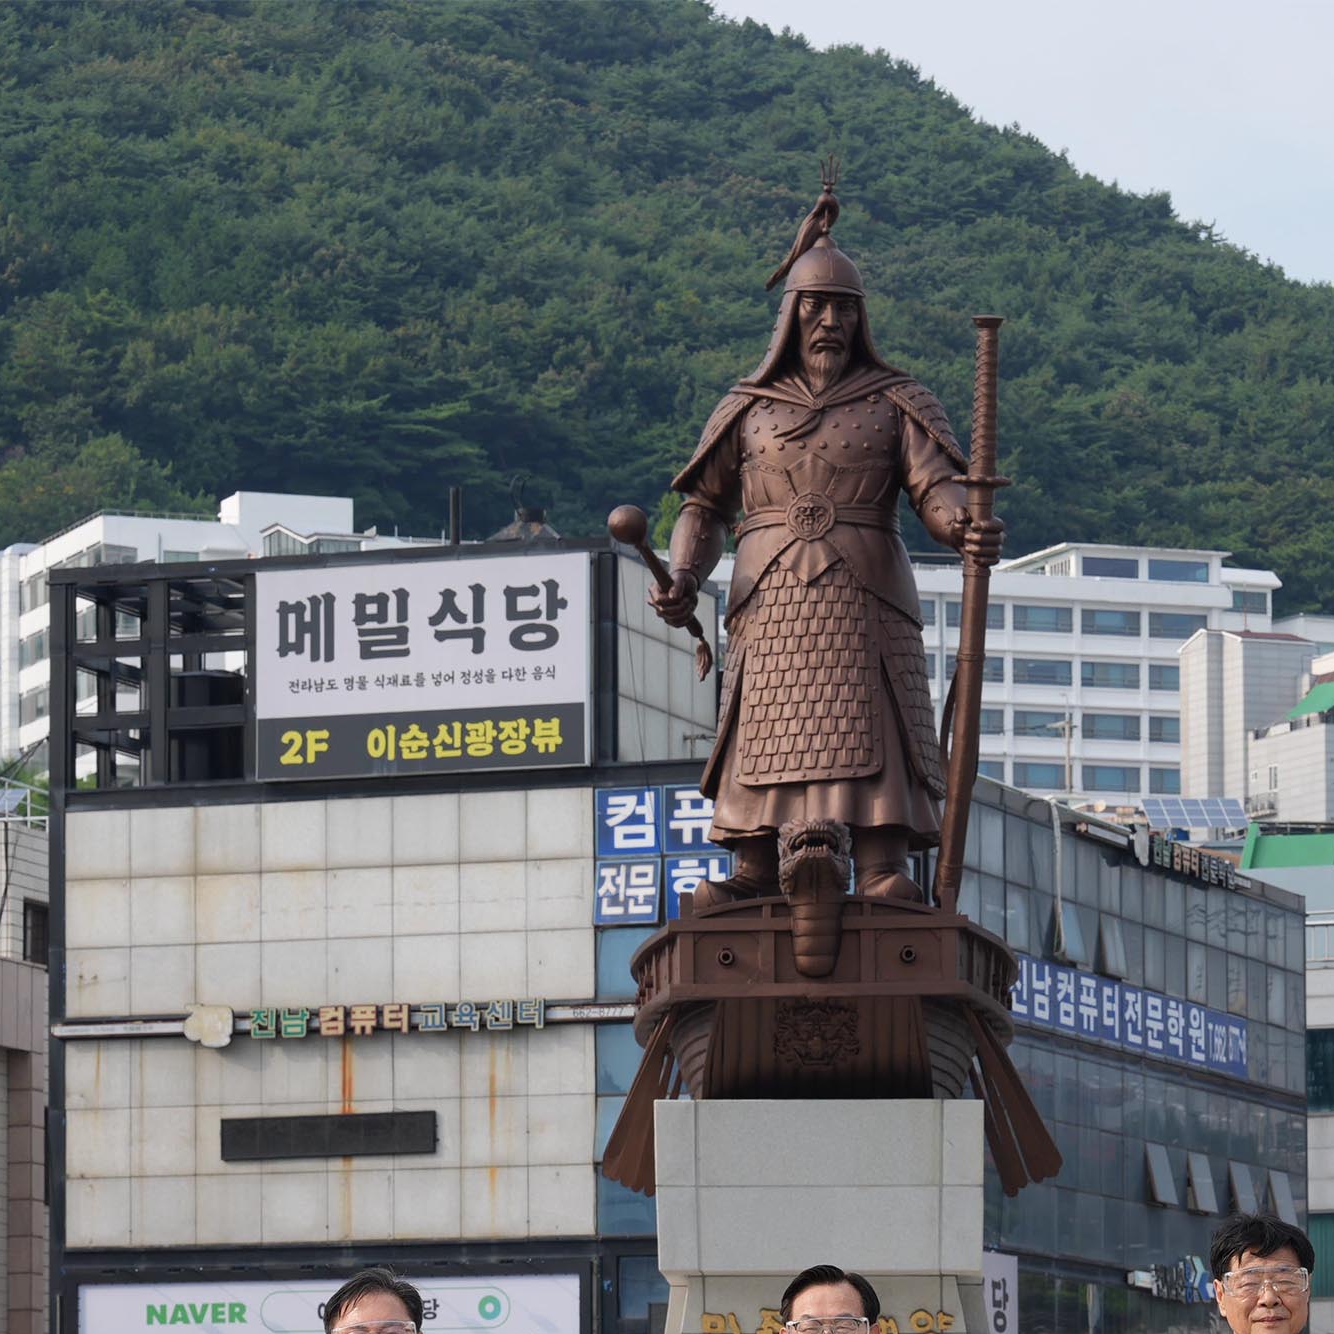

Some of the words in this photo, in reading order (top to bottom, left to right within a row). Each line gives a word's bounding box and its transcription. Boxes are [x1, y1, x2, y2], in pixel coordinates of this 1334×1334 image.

[276, 579, 569, 663] 메밀식당
[288, 678, 339, 693] 전라남도
[343, 676, 369, 691] 명물
[373, 672, 426, 689] 식재료를
[460, 668, 496, 685] 정성을
[501, 666, 527, 682] 다한
[531, 665, 556, 680] 음식
[279, 730, 331, 765] 2F
[367, 717, 564, 761] 이순신광장뷰
[250, 1008, 310, 1040] 진남
[318, 1004, 410, 1038] 컴퓨터
[419, 999, 547, 1033] 교육센터
[145, 1301, 248, 1326] NAVER
